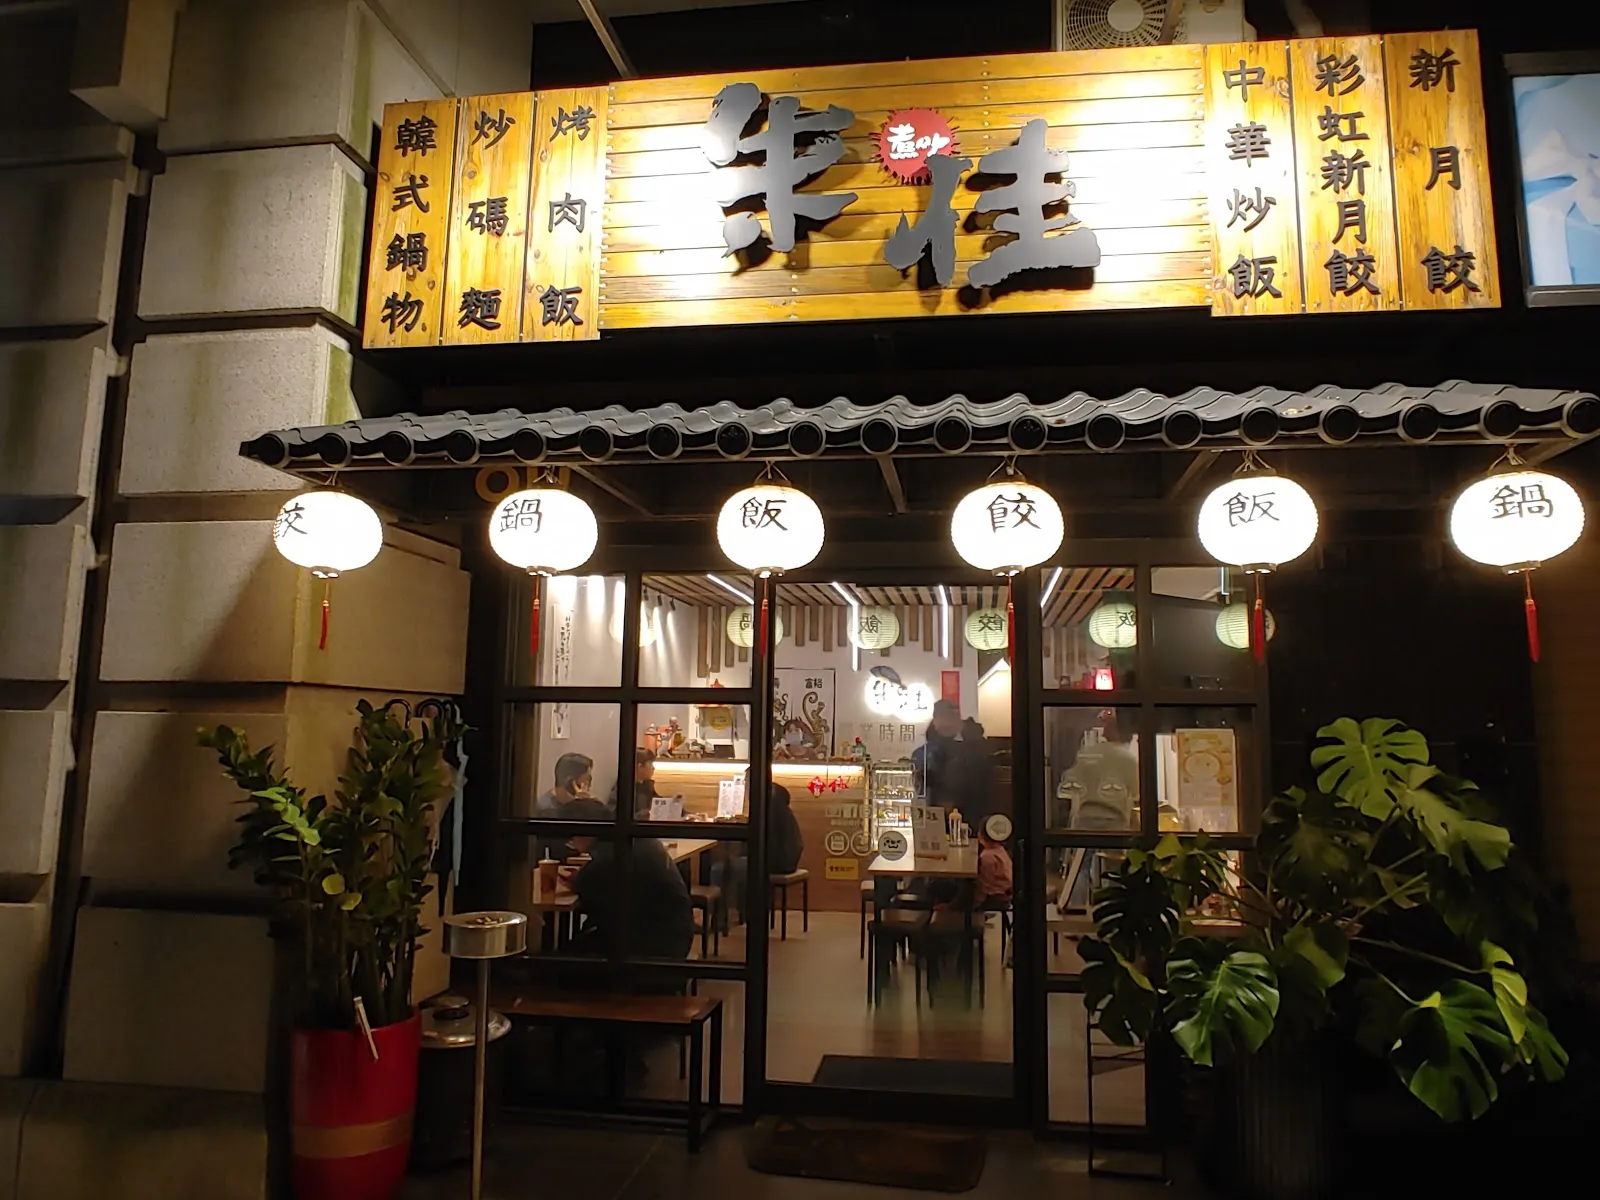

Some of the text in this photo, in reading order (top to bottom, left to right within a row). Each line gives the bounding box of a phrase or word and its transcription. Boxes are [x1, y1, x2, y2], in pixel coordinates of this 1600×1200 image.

[380, 115, 438, 335] 韓式鍋物
[457, 108, 516, 331] 炒碼麵
[537, 105, 597, 328] 烤肉飯
[1222, 59, 1284, 298] 中華炒飯
[1314, 53, 1381, 296] 彩虹新月餃
[1408, 47, 1482, 293] 新月餃
[499, 498, 542, 534] 鍋
[740, 496, 789, 532] 飯
[985, 492, 1042, 533] 餃
[1222, 491, 1280, 528] 飯
[1488, 484, 1555, 519] 鍋
